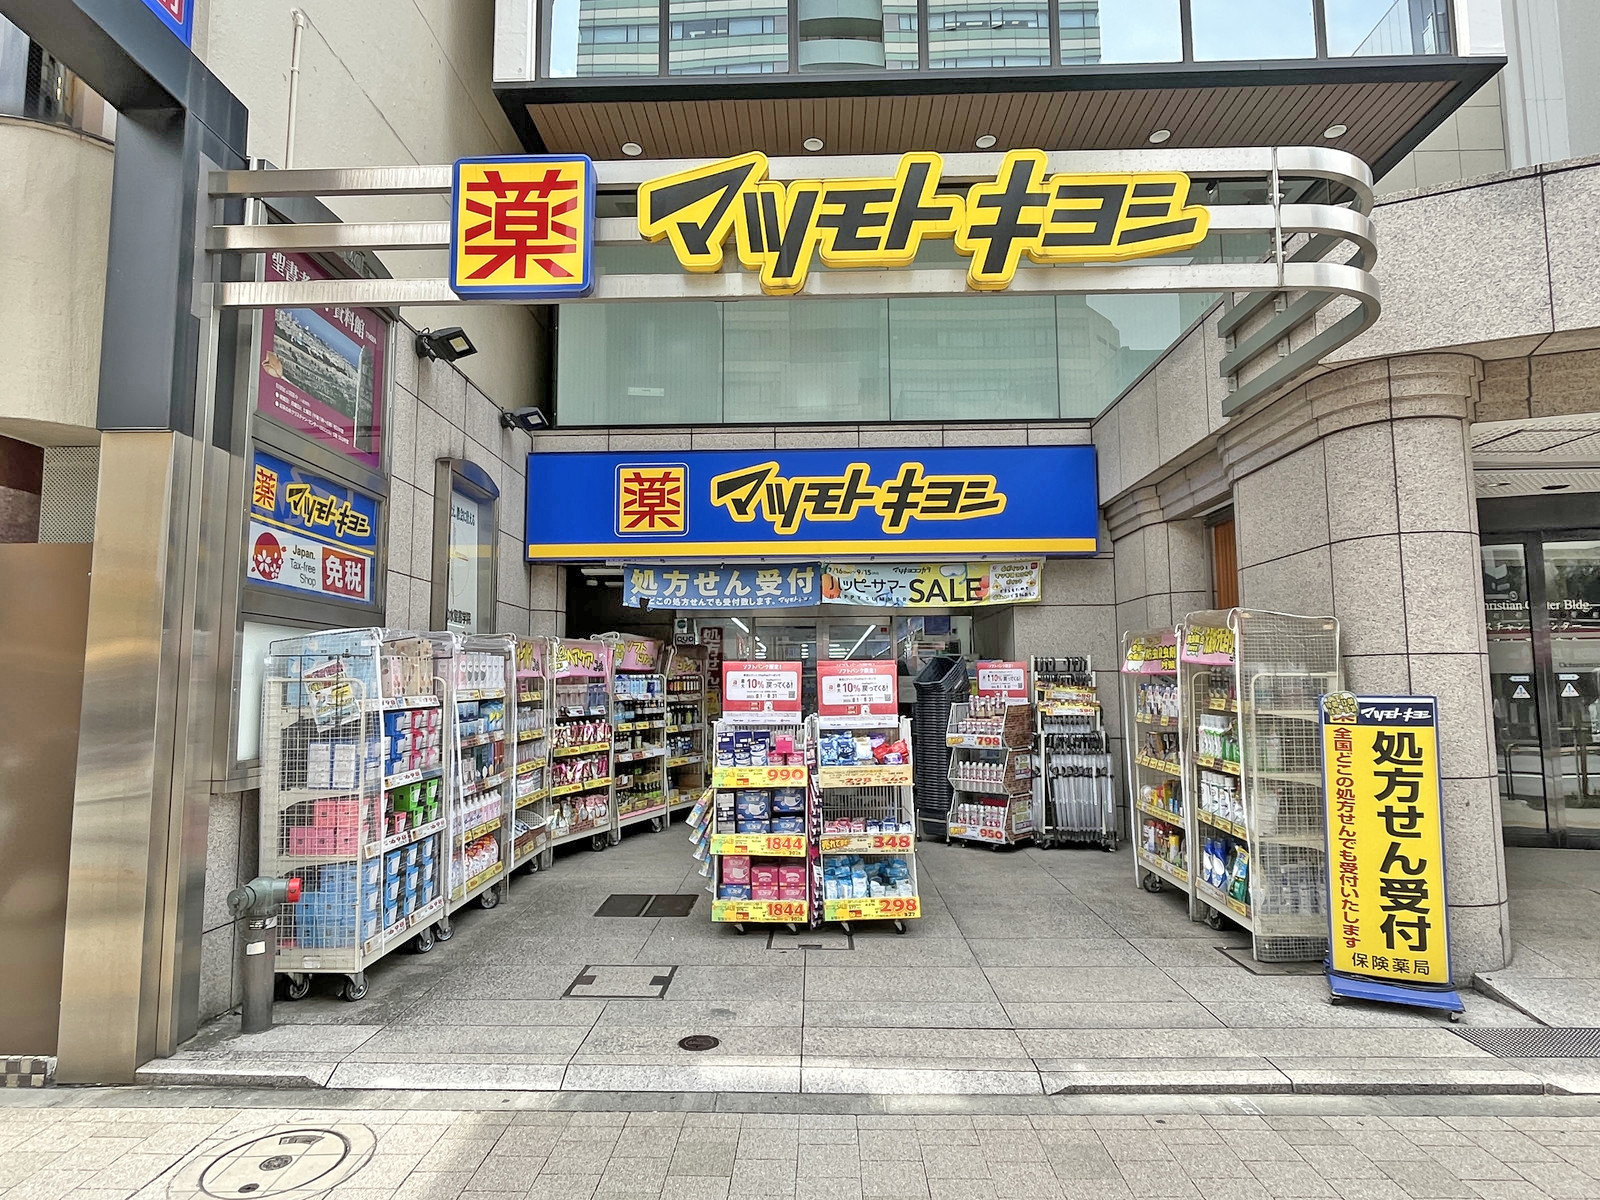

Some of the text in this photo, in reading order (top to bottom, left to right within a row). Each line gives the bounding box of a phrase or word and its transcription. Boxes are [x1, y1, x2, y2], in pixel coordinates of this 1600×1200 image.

[464, 168, 578, 281] 薬
[638, 149, 1208, 292] マツモトキヨシ
[254, 468, 370, 537] 薬 マツモトキヨシ
[621, 461, 1007, 535] 薬 マツモトキヨシ
[292, 544, 316, 560] Japan.
[290, 557, 316, 575] Tax-free
[325, 554, 362, 593] 免税
[299, 573, 316, 588] Shop
[630, 567, 815, 597] 処方せん受付
[829, 576, 906, 594] ハッピーサマー
[908, 577, 983, 603] SALE
[1485, 600, 1522, 610] hristian
[1563, 599, 1593, 612] Bldg.
[747, 679, 764, 689] 10%
[843, 683, 860, 693] 10%
[1360, 706, 1432, 722] マツモトキヨシ
[976, 736, 1000, 746] 798
[767, 768, 804, 781] 990
[873, 835, 911, 848] 348
[980, 828, 1003, 840] 950
[1332, 727, 1361, 949] 全国どこの処方せんでも受付いたします
[1371, 729, 1432, 953] 処方せん受付
[765, 837, 803, 849] 1844
[767, 903, 805, 916] 1844
[879, 899, 917, 912] 298
[1351, 952, 1430, 976] 保険薬局
